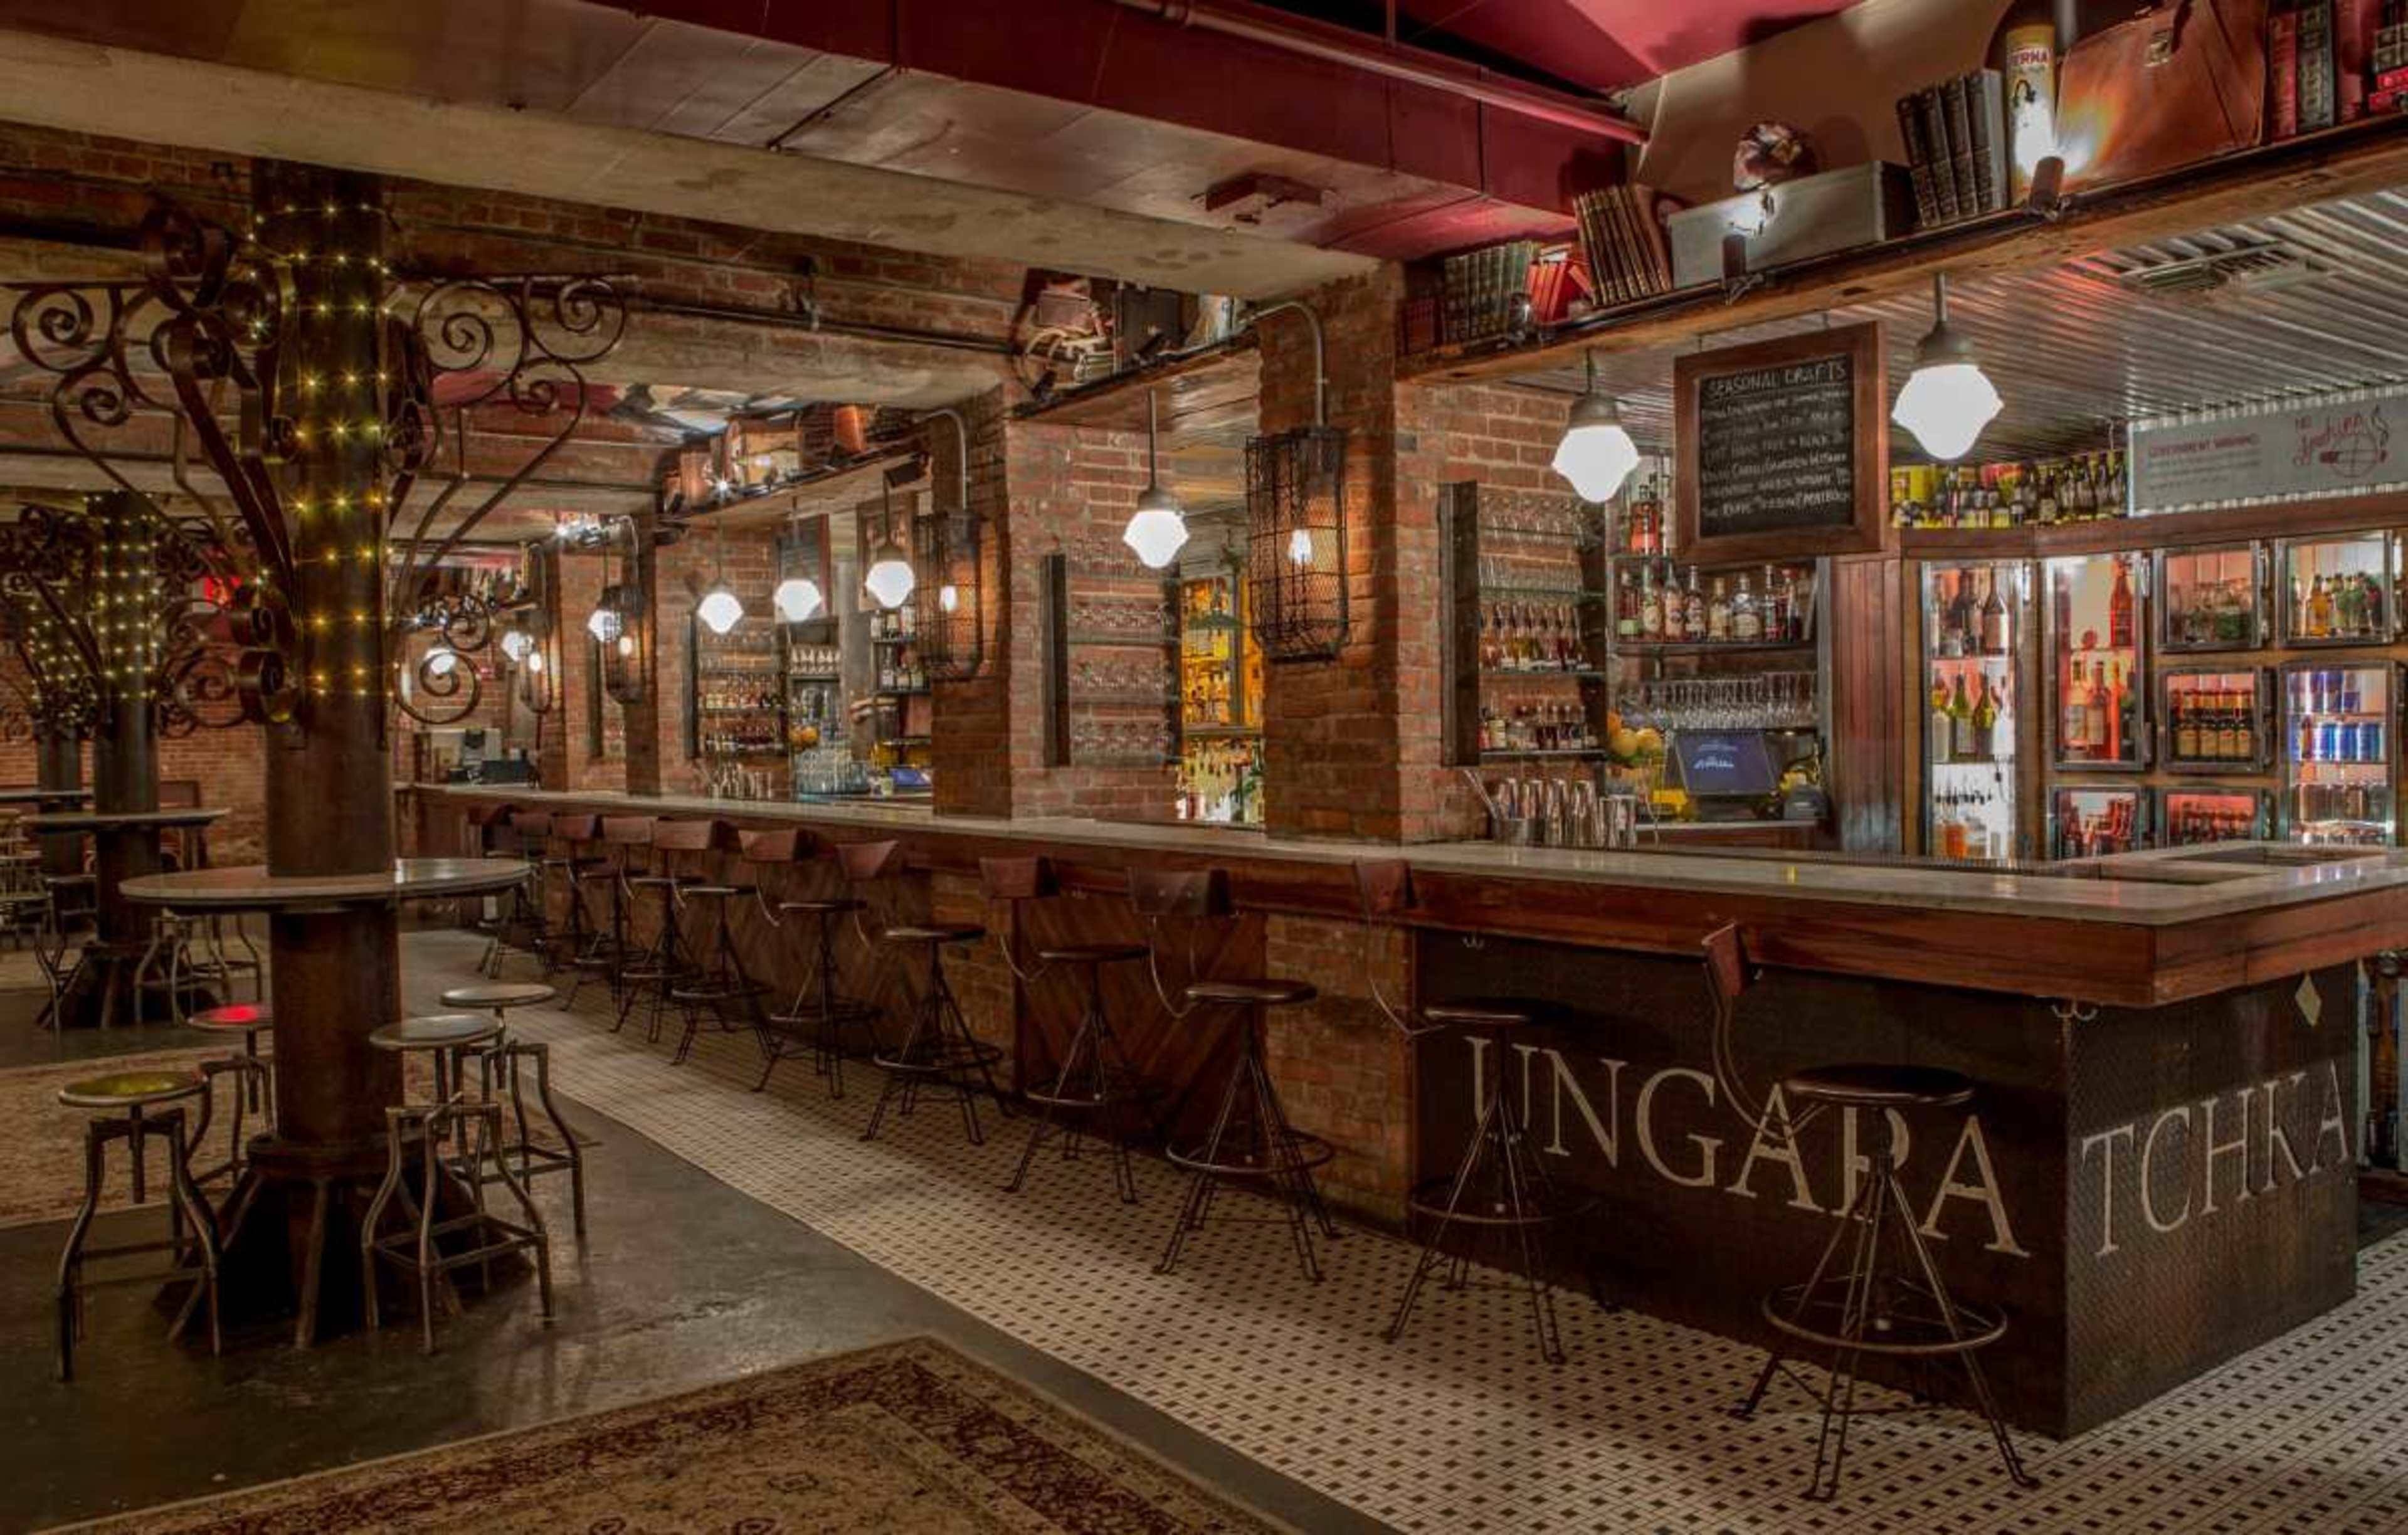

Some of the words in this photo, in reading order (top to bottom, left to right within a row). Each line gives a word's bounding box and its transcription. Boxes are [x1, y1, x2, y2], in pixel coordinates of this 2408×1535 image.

[1708, 369, 1780, 395] SEASONAL
[1785, 361, 1847, 385] CRAFTS
[2082, 1059, 2349, 1258] TCHKA
